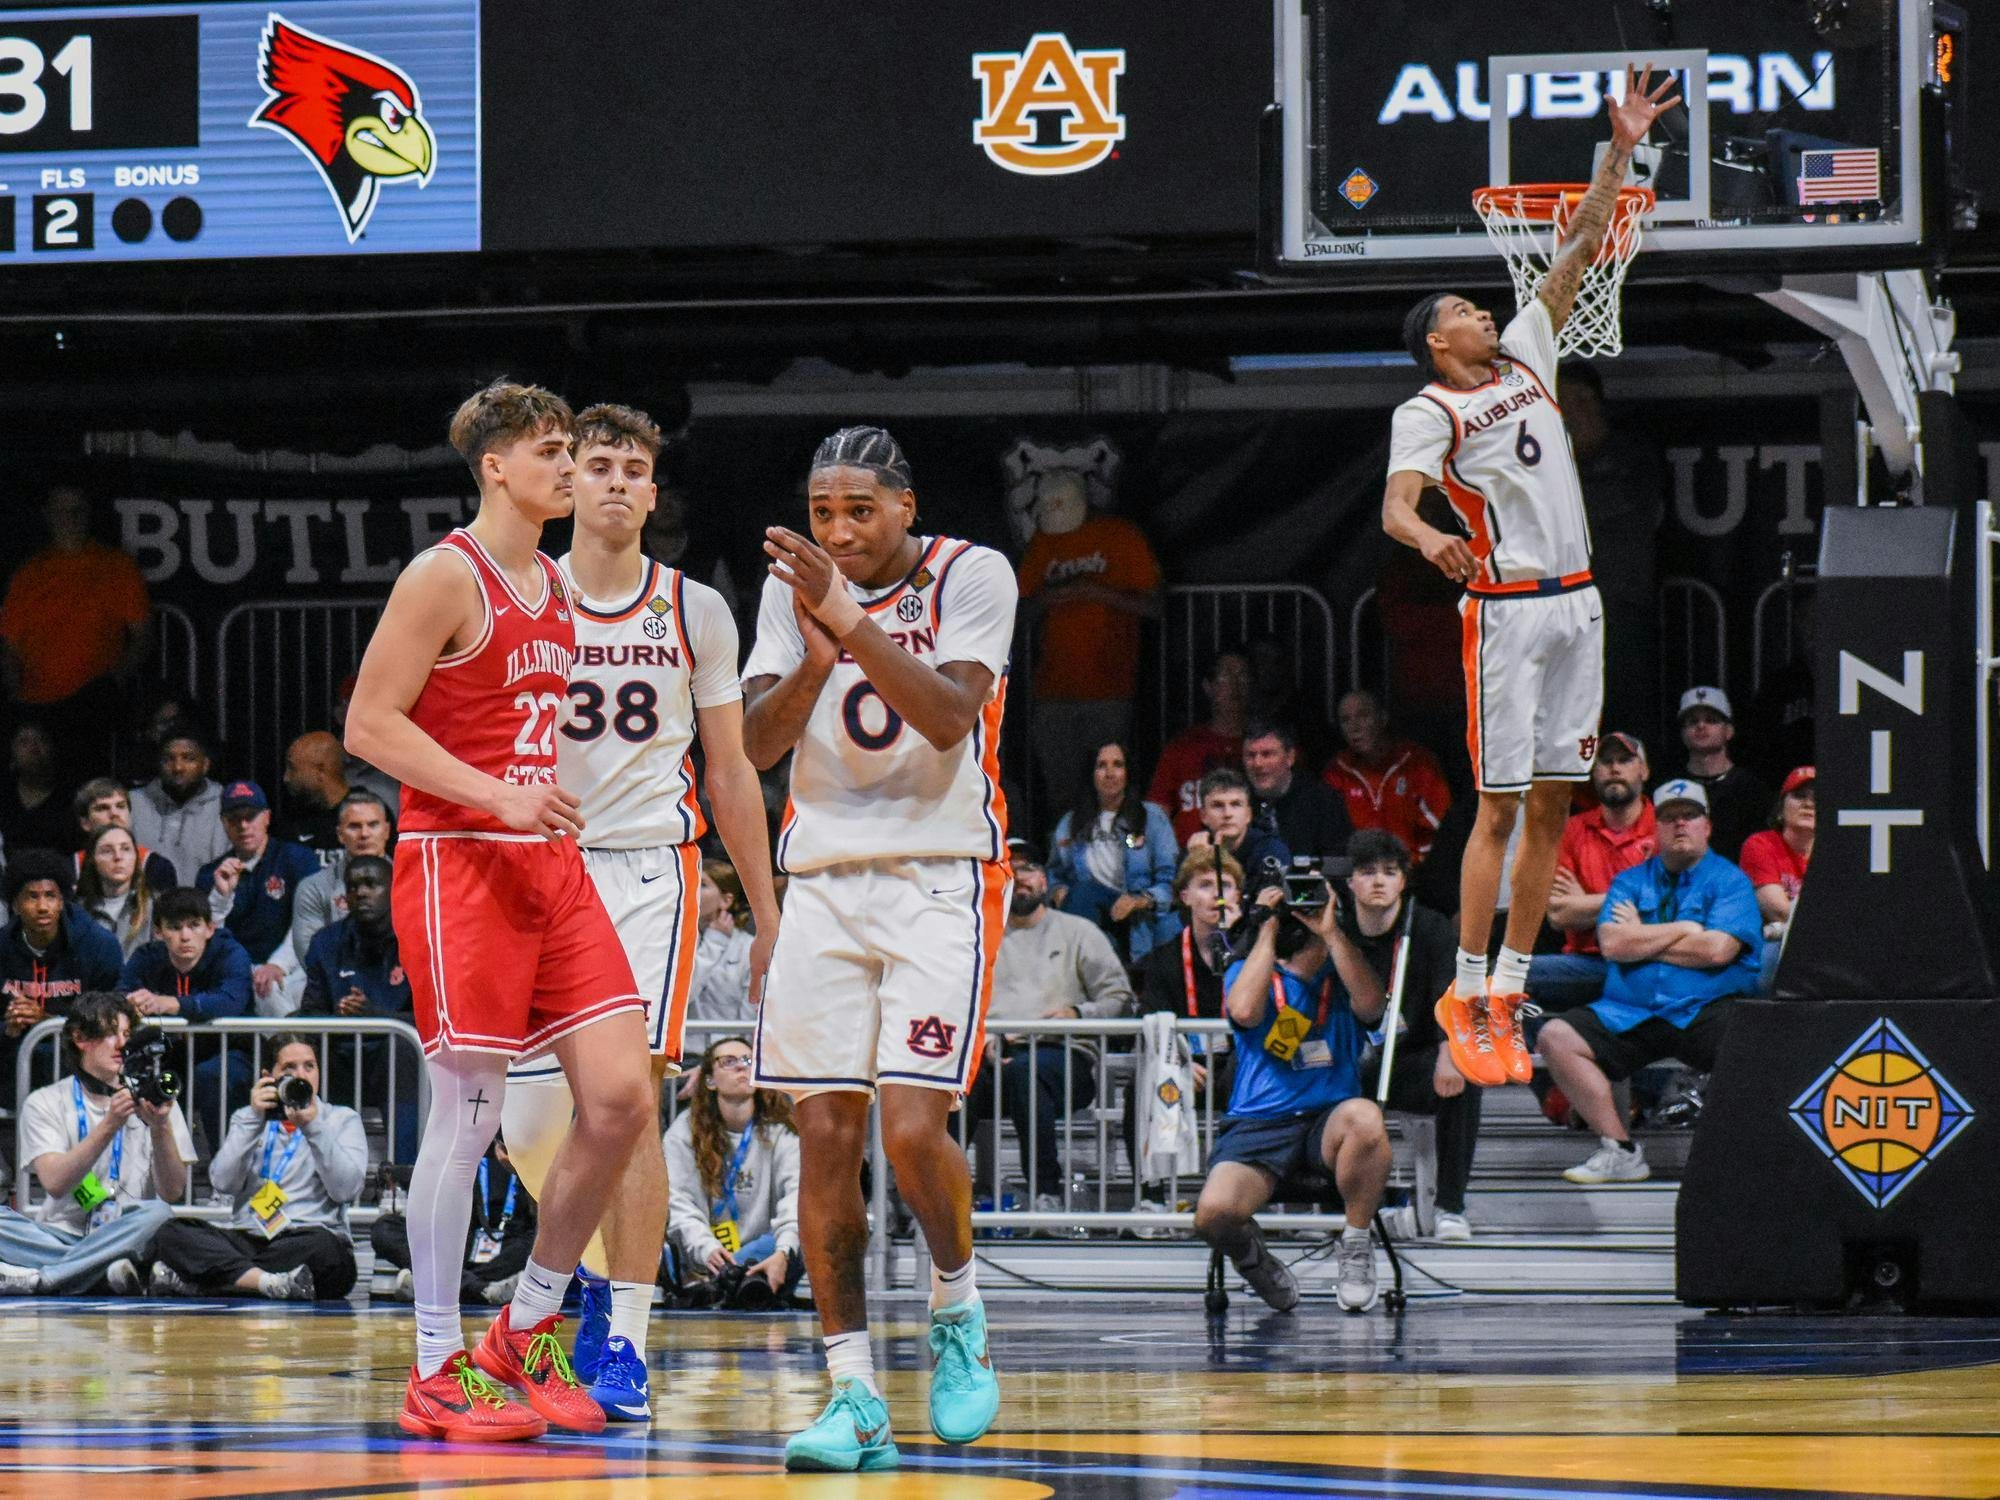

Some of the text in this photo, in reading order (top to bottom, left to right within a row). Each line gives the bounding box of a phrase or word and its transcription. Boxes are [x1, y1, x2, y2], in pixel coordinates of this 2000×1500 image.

[41, 164, 199, 189] FLS BONUS
[45, 198, 78, 244] 2
[1304, 241, 1365, 257] SPALDING
[1463, 385, 1543, 438] AUBURN
[1515, 419, 1542, 467] 6
[113, 496, 479, 584] BUTLE
[643, 617, 667, 639] SEC
[897, 595, 923, 622] SEC
[513, 691, 562, 756] 22
[558, 680, 660, 743] 38
[1833, 1096, 1932, 1129] NIT
